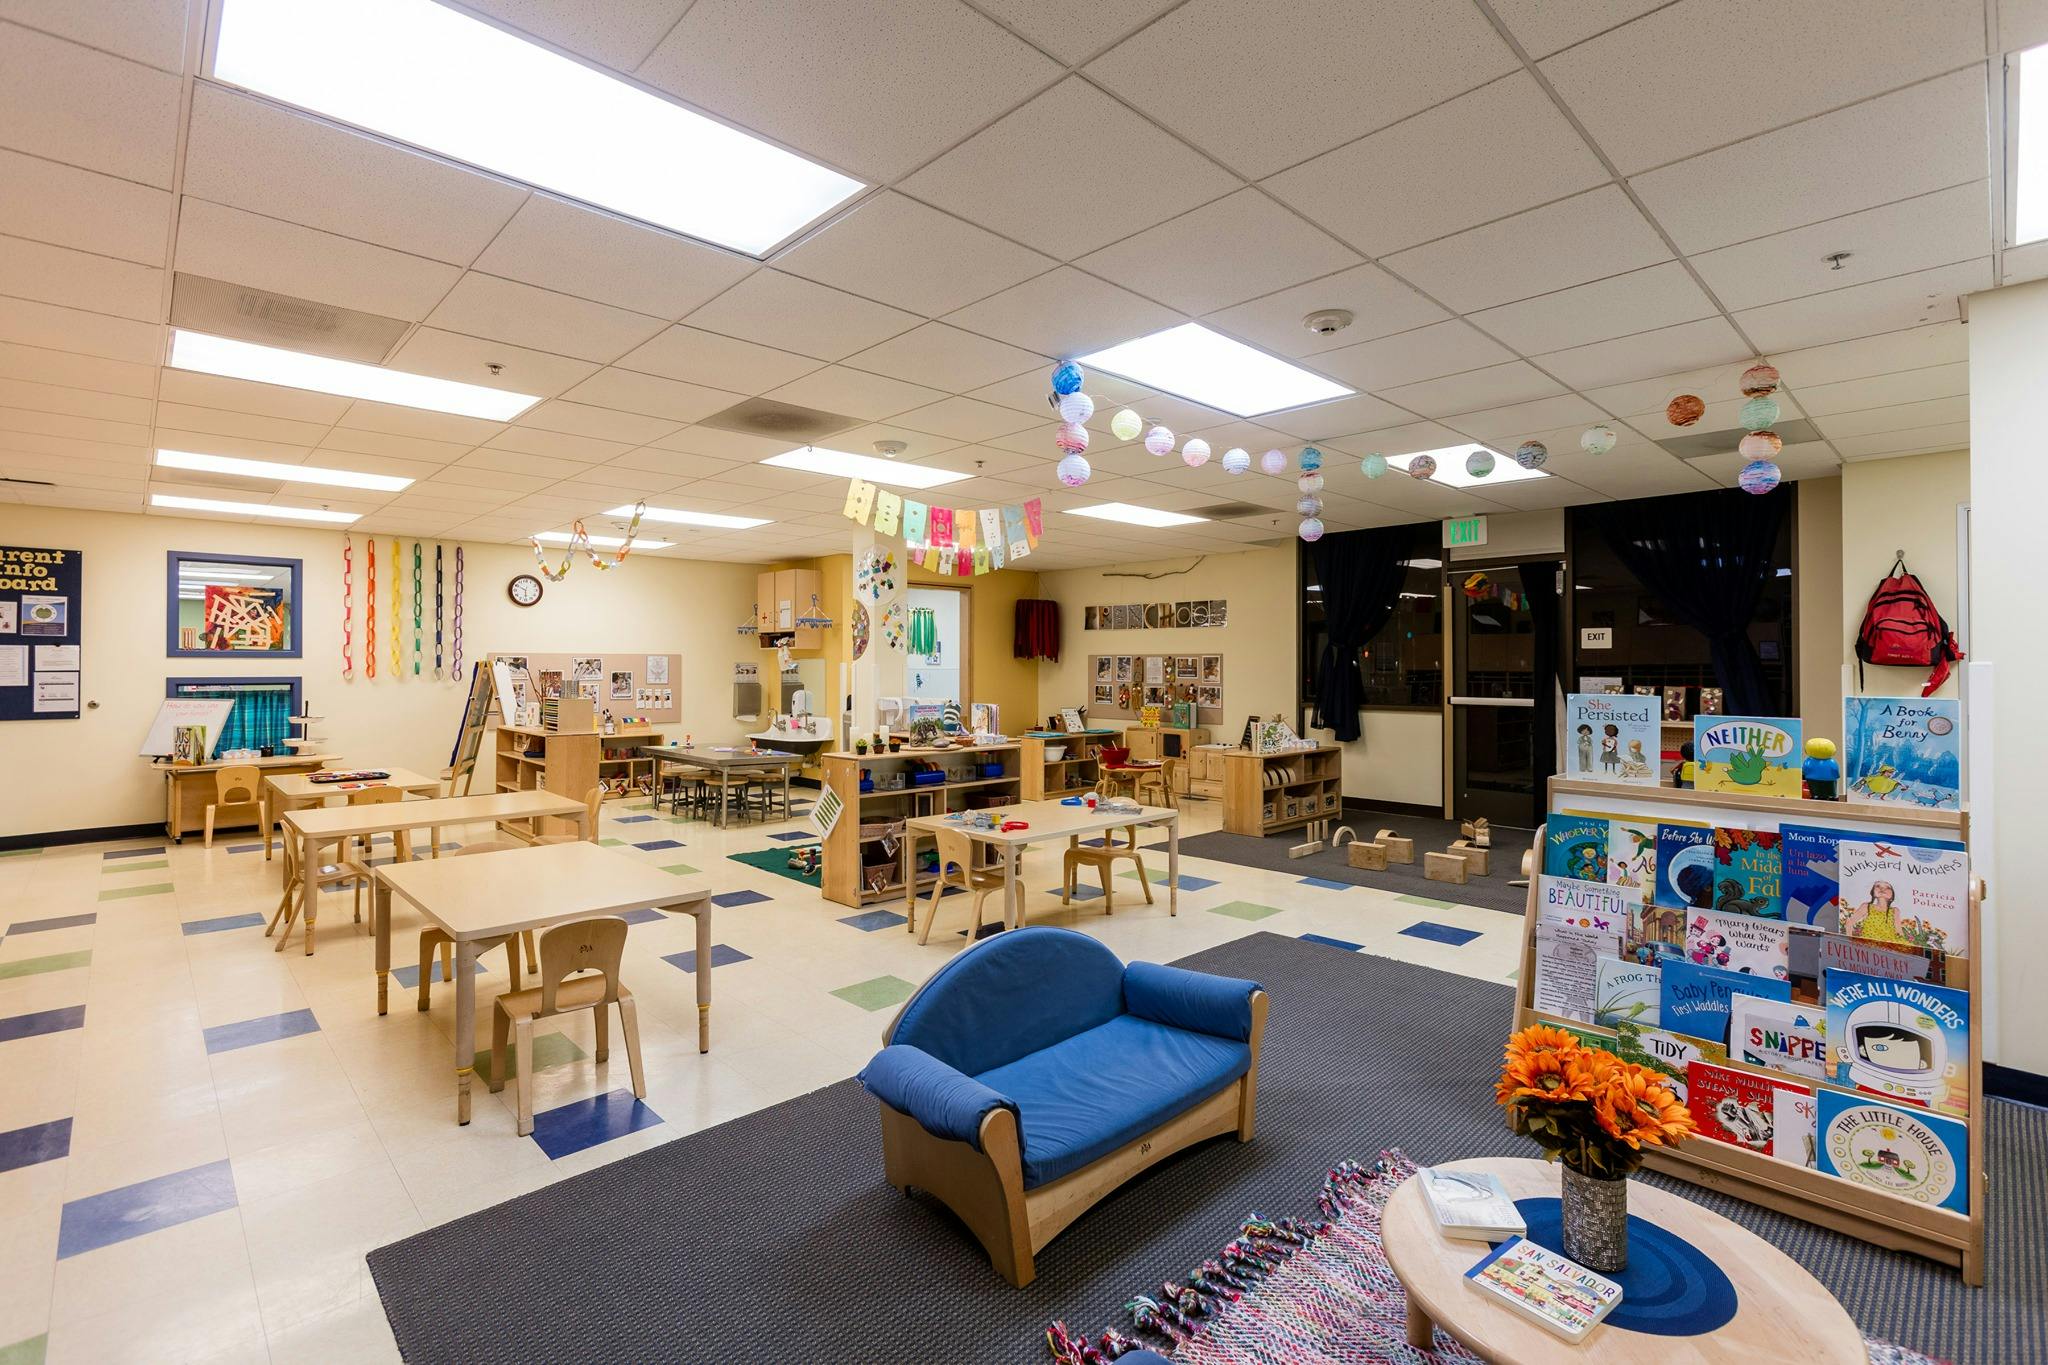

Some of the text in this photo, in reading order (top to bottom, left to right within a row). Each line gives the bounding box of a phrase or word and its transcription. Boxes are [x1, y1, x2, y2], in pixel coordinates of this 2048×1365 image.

[1451, 519, 1480, 545] EXIT
[0, 562, 48, 577] nfo
[1587, 632, 1605, 641] EXIT
[1588, 699, 1611, 710] She
[1881, 705, 1936, 717] A Book
[1577, 706, 1649, 722] Persisted
[1898, 718, 1916, 728] for
[1706, 727, 1785, 753] NEITHER
[1882, 725, 1928, 741] Benny
[1550, 828, 1600, 845] WHOEVER
[1662, 829, 1715, 846] Before She W
[1788, 832, 1815, 843] Moon
[1756, 850, 1779, 859] In the
[1789, 848, 1804, 858] Un
[1741, 858, 1781, 874] Midd
[1843, 859, 1962, 877] Junkyard Wonders
[1556, 880, 1621, 896] Maybe Something
[1912, 889, 1955, 901] Patricia
[1549, 887, 1628, 916] BEAUTIFUL
[1913, 898, 1955, 909] Polacco
[1715, 918, 1785, 938] Mary Wears
[1728, 929, 1776, 944] What She
[1735, 940, 1770, 952] Wants
[1827, 941, 1909, 976] EVELYN DEL REY
[1606, 981, 1614, 989] A
[1614, 973, 1643, 986] FROG
[1672, 983, 1707, 1001] Baby
[1693, 1000, 1729, 1014] Waddles
[1868, 982, 1892, 997] ALL
[1894, 983, 1965, 1030] WONDERS
[1649, 1038, 1687, 1060] TIDY
[1704, 1068, 1730, 1082] MIKE
[1697, 1079, 1739, 1097] STEAM
[1835, 1110, 1944, 1157] THE LITTLE HOUSE
[1517, 1245, 1616, 1298] SAN SALVADOR
